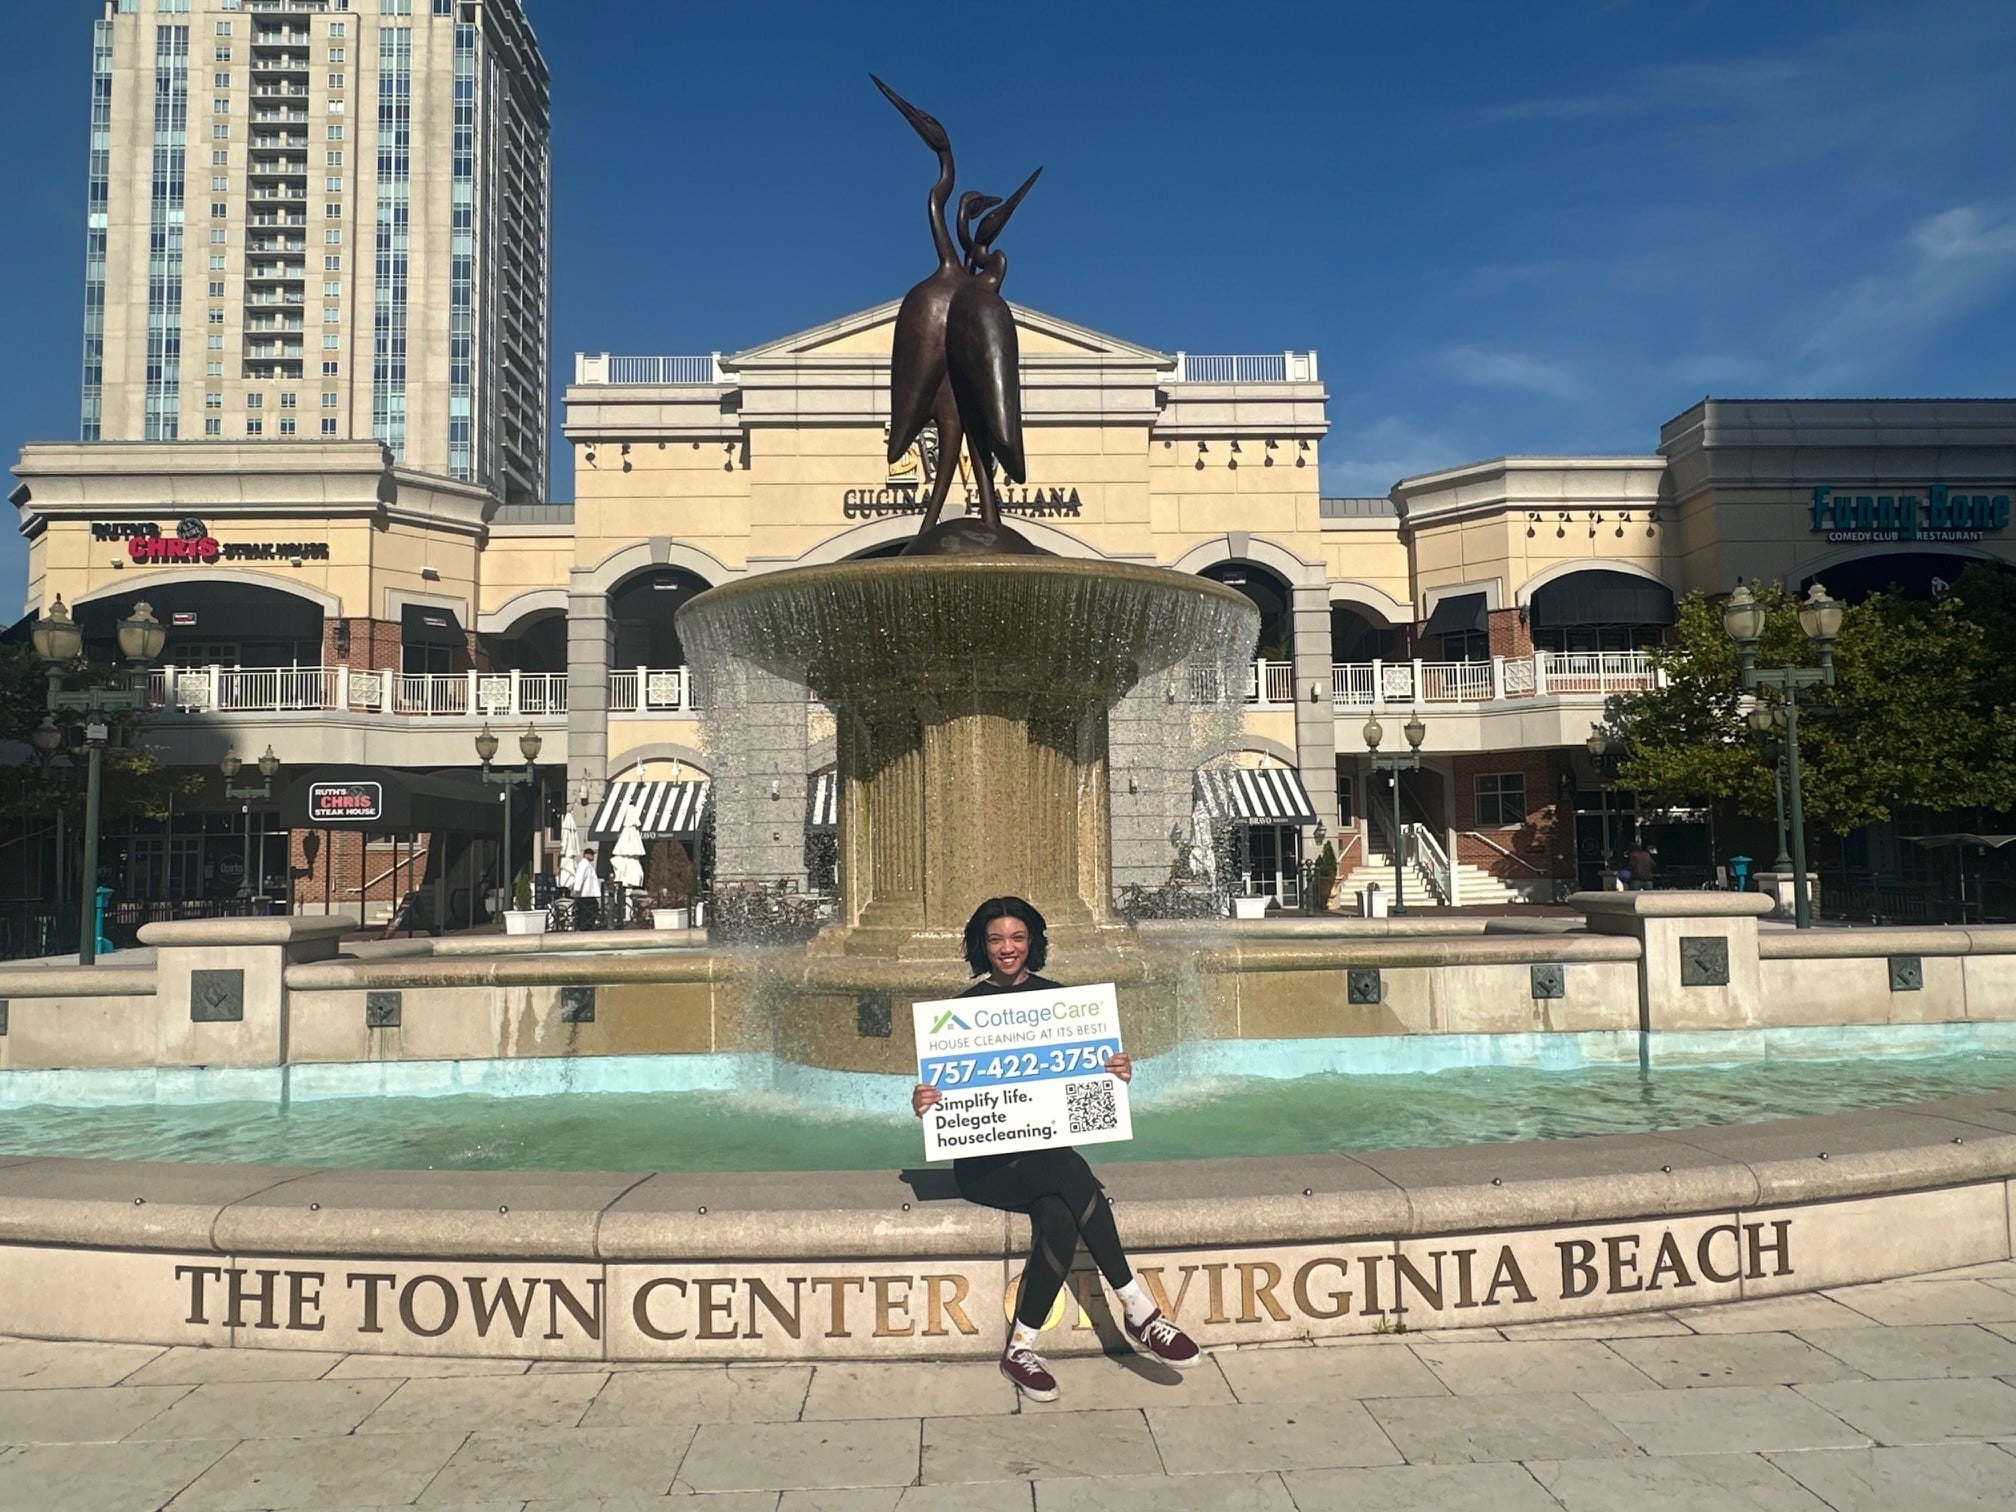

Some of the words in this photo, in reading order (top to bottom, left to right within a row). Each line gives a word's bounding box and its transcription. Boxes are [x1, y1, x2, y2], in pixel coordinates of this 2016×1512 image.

[1814, 485, 1917, 539] Funny
[1930, 485, 2011, 530] Bone
[1829, 531, 1872, 541] COMEDY
[1873, 531, 1898, 541] CLUB
[1916, 531, 1984, 540] RESTAURANT
[129, 537, 219, 560] CHRIS
[314, 788, 347, 796] RUTH'S
[320, 795, 372, 808] CHRIS
[314, 808, 344, 816] STEAK
[345, 807, 376, 815] HOUSE
[974, 1001, 1100, 1028] CottageCare
[929, 1037, 970, 1051] HOUSE
[974, 1030, 1036, 1047] CLEANING
[1041, 1028, 1053, 1039] AT
[1057, 1026, 1073, 1037] ITS
[1077, 1023, 1107, 1036] BEST!
[928, 1045, 1114, 1087] 757-422-3750
[934, 1092, 999, 1113] Simplify
[1003, 1089, 1033, 1104] life.
[936, 1111, 1007, 1129] Delegate
[937, 1123, 1057, 1148] housecleaning.
[174, 1265, 325, 1331] THE
[346, 1273, 606, 1340] TOWN
[632, 1273, 979, 1340] CENTER
[1137, 1244, 1537, 1325] VIRGINIA
[1555, 1220, 1793, 1300] BEACH
